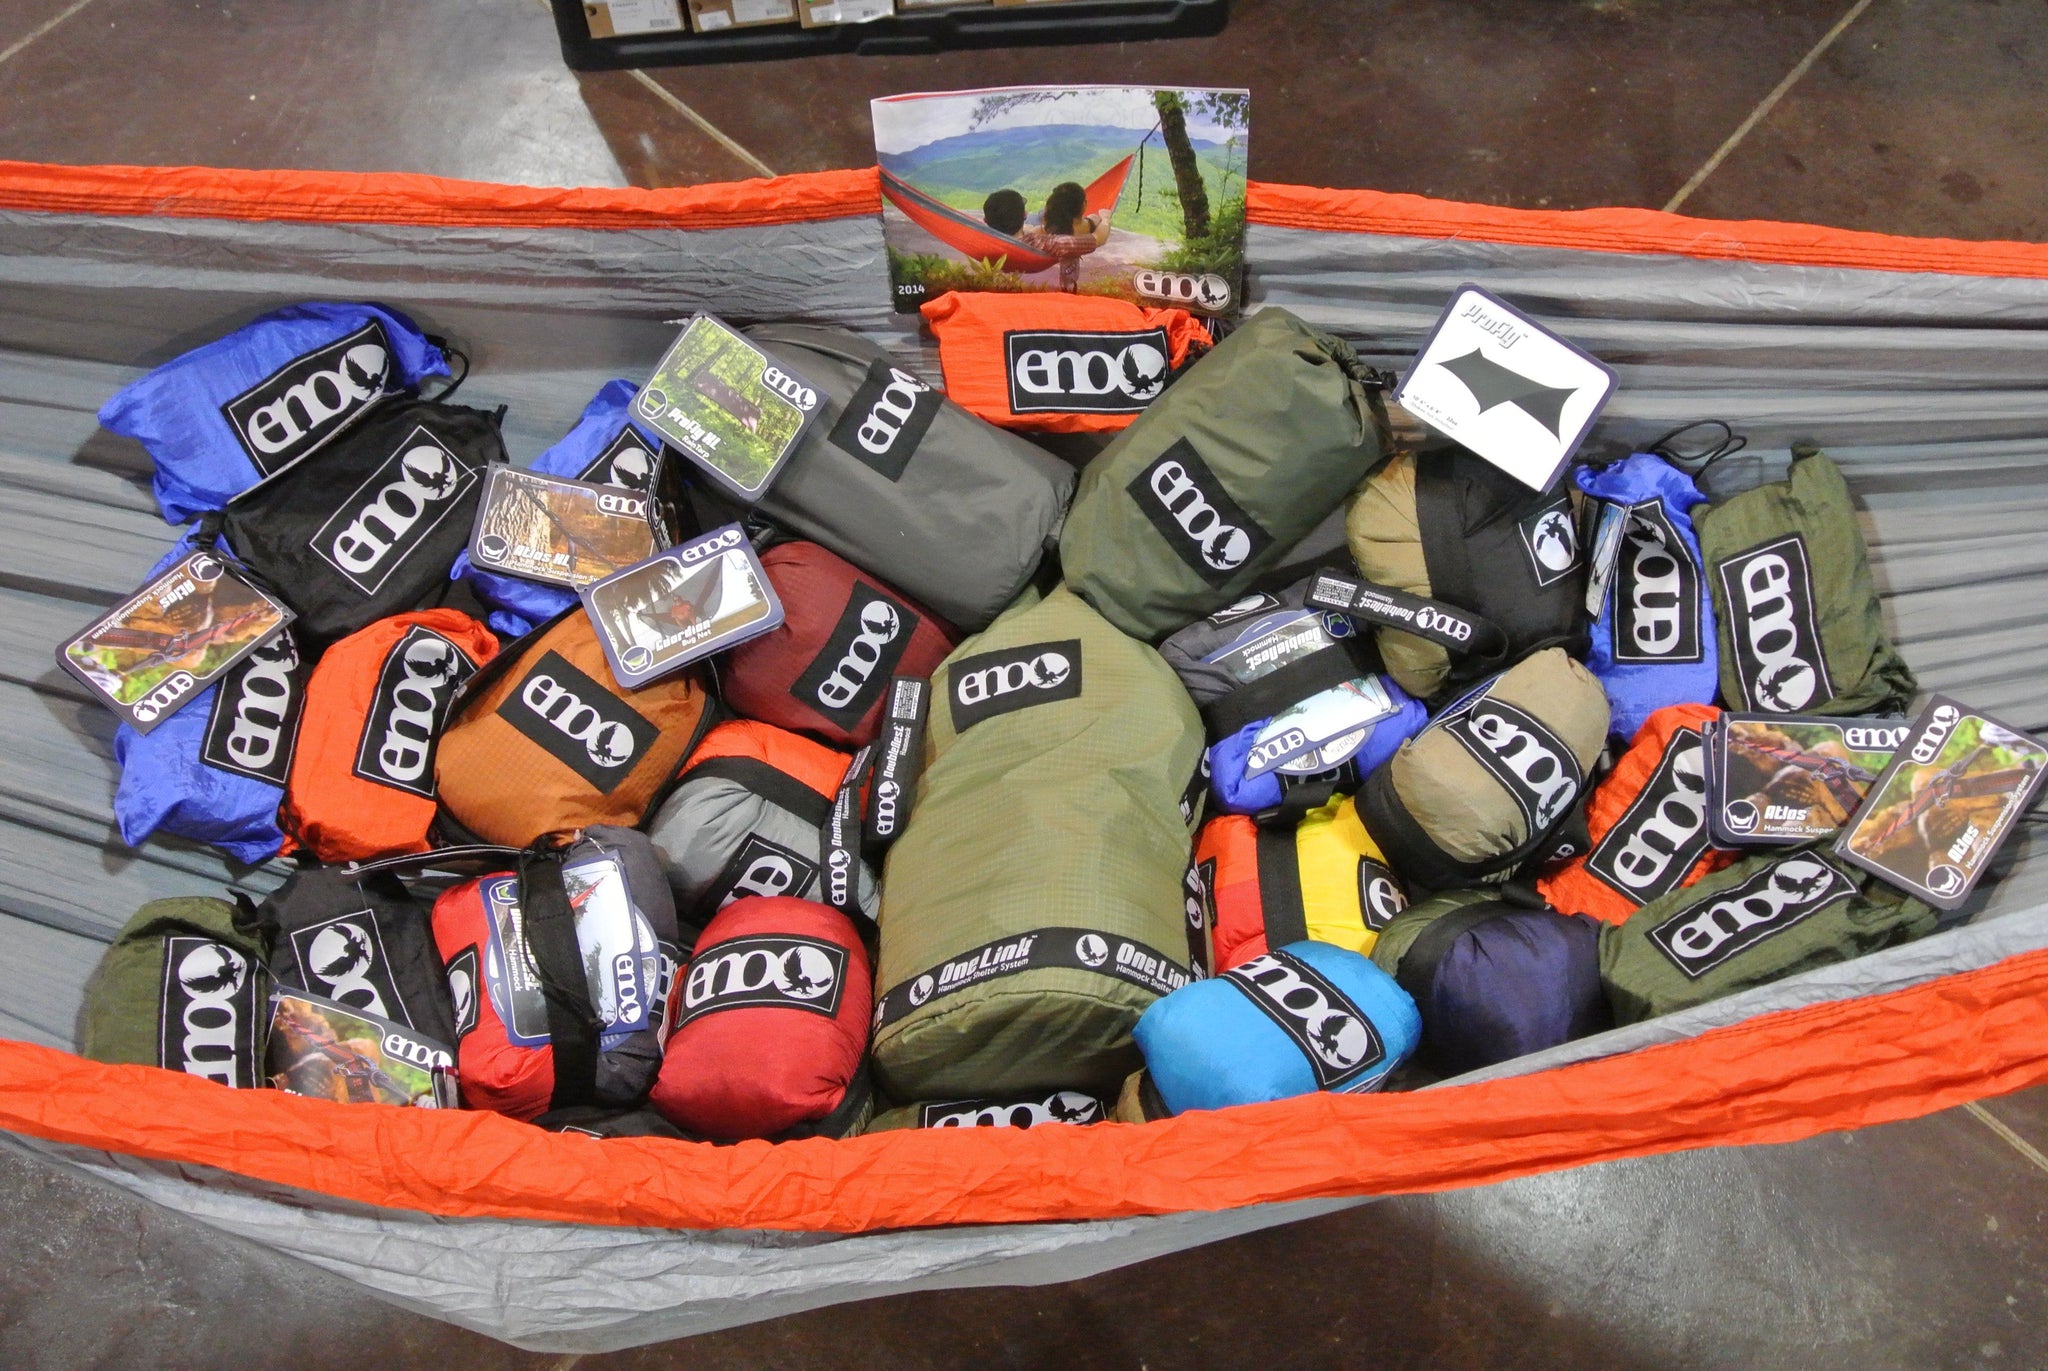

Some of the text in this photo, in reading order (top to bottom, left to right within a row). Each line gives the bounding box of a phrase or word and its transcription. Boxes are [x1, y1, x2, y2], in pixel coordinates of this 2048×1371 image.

[898, 284, 925, 295] 2014
[1136, 271, 1199, 299] eno
[1461, 303, 1521, 349] ProFly
[1015, 350, 1120, 394] eno
[248, 370, 352, 453] eno
[857, 382, 916, 454] eno
[682, 434, 710, 457] Rain Tarp
[702, 431, 721, 450] XL
[599, 494, 644, 514] eno
[152, 571, 184, 596] Hammock
[158, 579, 196, 610] Atlas
[1632, 548, 1680, 654] eno
[1741, 553, 1798, 658] eno
[655, 620, 711, 650] Guardian
[682, 630, 712, 648] Bug Net
[1242, 635, 1279, 657] Hammock
[1433, 613, 1472, 641] eno
[817, 632, 881, 708] eno
[1246, 627, 1322, 671] DoubleNest
[958, 661, 1031, 706] eno
[227, 665, 290, 768] eno
[378, 678, 437, 781] eno
[1845, 727, 1895, 747] eno
[884, 724, 905, 778] DoubleNest
[1468, 713, 1563, 796] eno
[1911, 718, 1950, 762] eno
[876, 798, 896, 835] eno
[1764, 805, 1807, 820] Atlas
[1764, 824, 1803, 833] Hammock
[1614, 792, 1706, 888] eno
[1947, 823, 1979, 863] Atlas
[831, 864, 848, 906] eno
[1671, 889, 1784, 958] eno
[508, 949, 522, 992] Hammock
[616, 954, 638, 1001] eno
[685, 949, 780, 1009] eno
[938, 936, 1033, 986] OneLink
[1000, 957, 1029, 972] System
[1115, 963, 1150, 984] Hammock
[384, 1033, 434, 1065] eno
